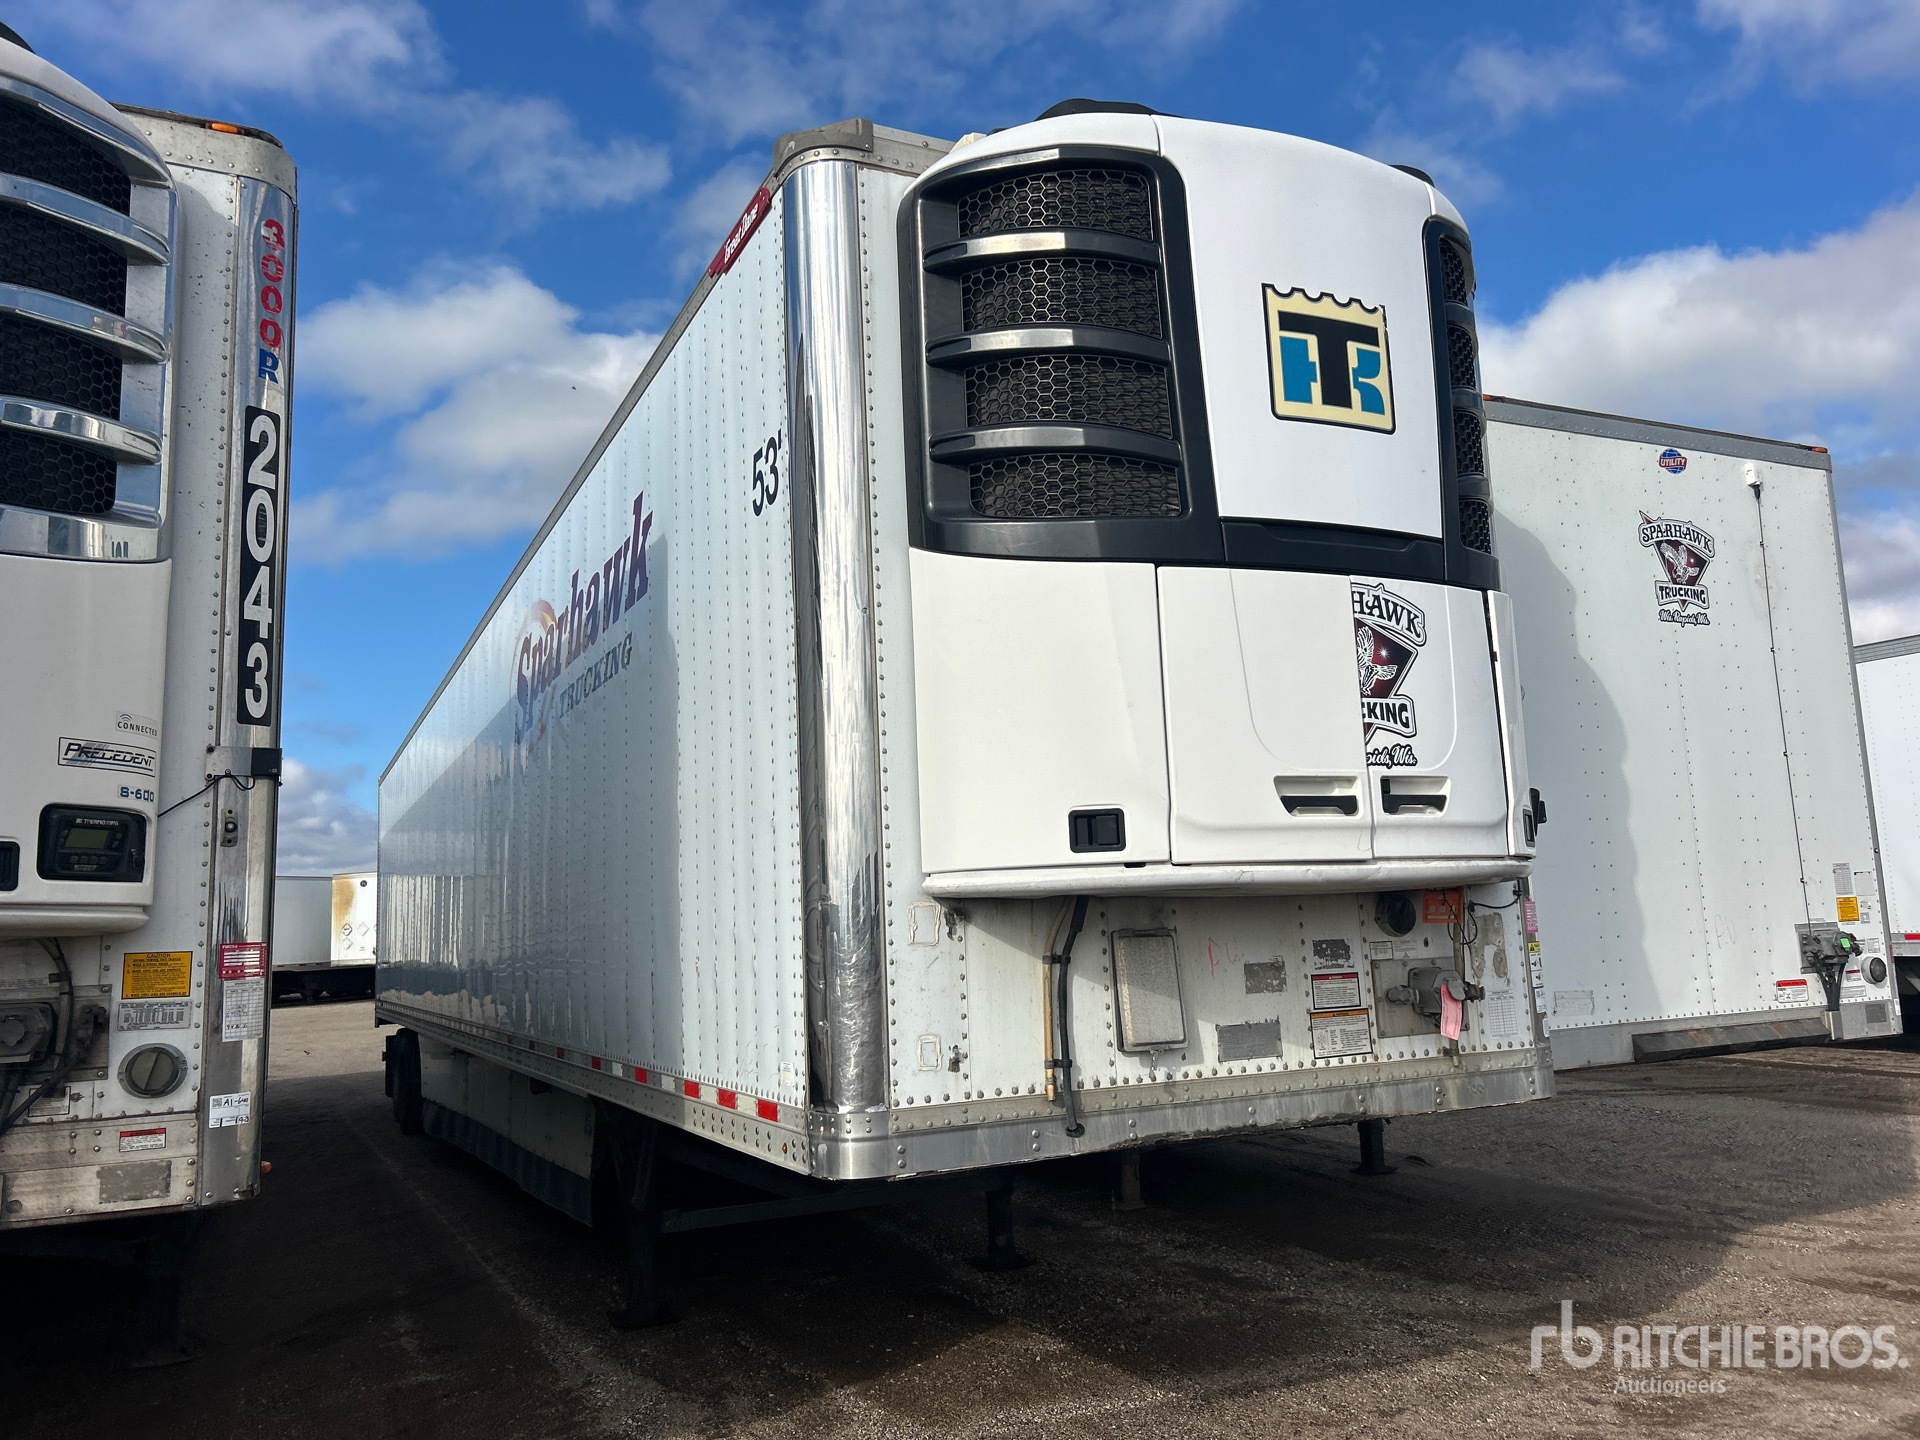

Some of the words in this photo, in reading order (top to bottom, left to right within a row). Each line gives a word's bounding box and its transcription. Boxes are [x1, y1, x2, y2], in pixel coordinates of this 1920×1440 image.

[724, 226, 742, 264] Great
[741, 203, 758, 240] Dane
[752, 428, 782, 517] 53'
[1660, 457, 1686, 467] UTILITY
[1641, 523, 1713, 554] SPARHAWK
[244, 414, 278, 719] 2043
[515, 490, 653, 745] Sparhawk
[1658, 585, 1707, 605] TRUCKING
[559, 630, 633, 719] TRUCKING
[117, 721, 158, 737] CONNECTED
[63, 742, 156, 767] PRECEDENT
